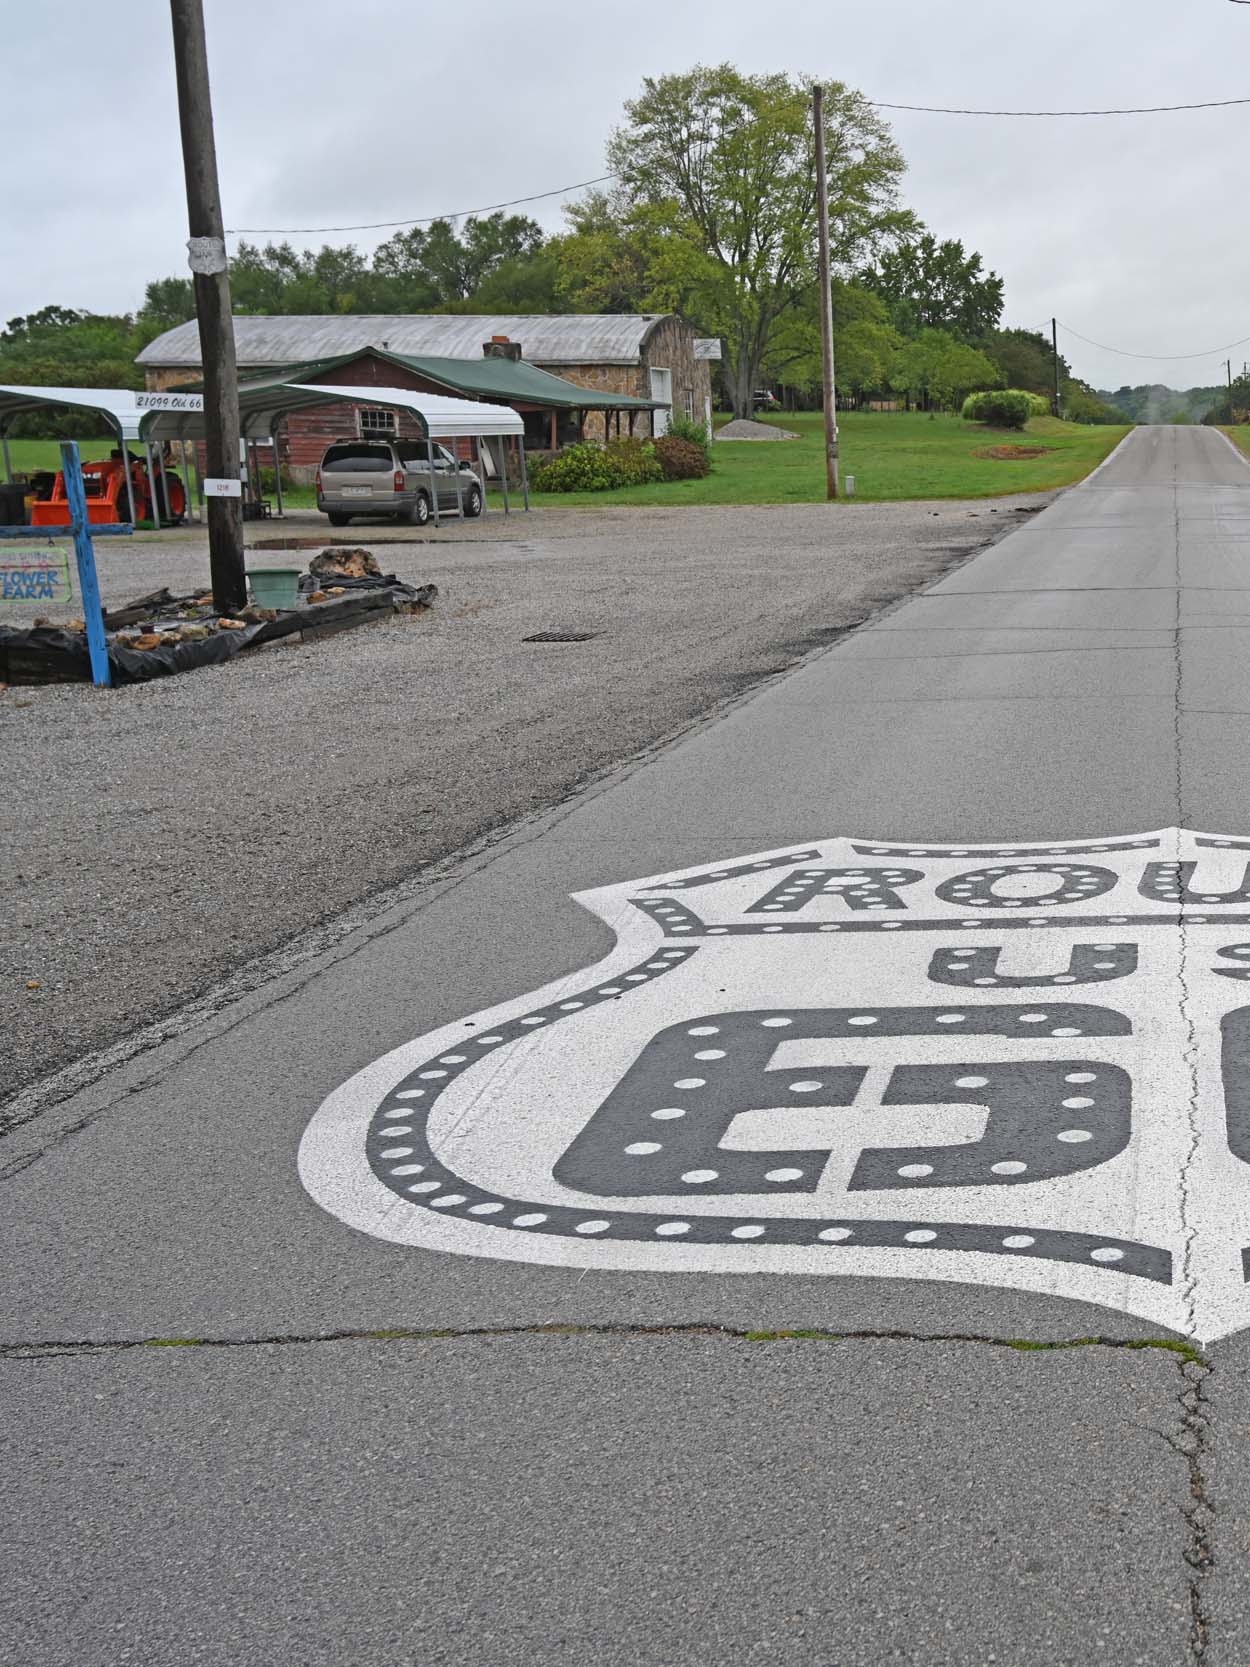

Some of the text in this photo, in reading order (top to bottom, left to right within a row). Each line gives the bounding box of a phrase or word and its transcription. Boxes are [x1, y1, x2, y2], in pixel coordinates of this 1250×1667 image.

[137, 396, 202, 408] 21099 Old 66
[3, 584, 54, 600] FARM
